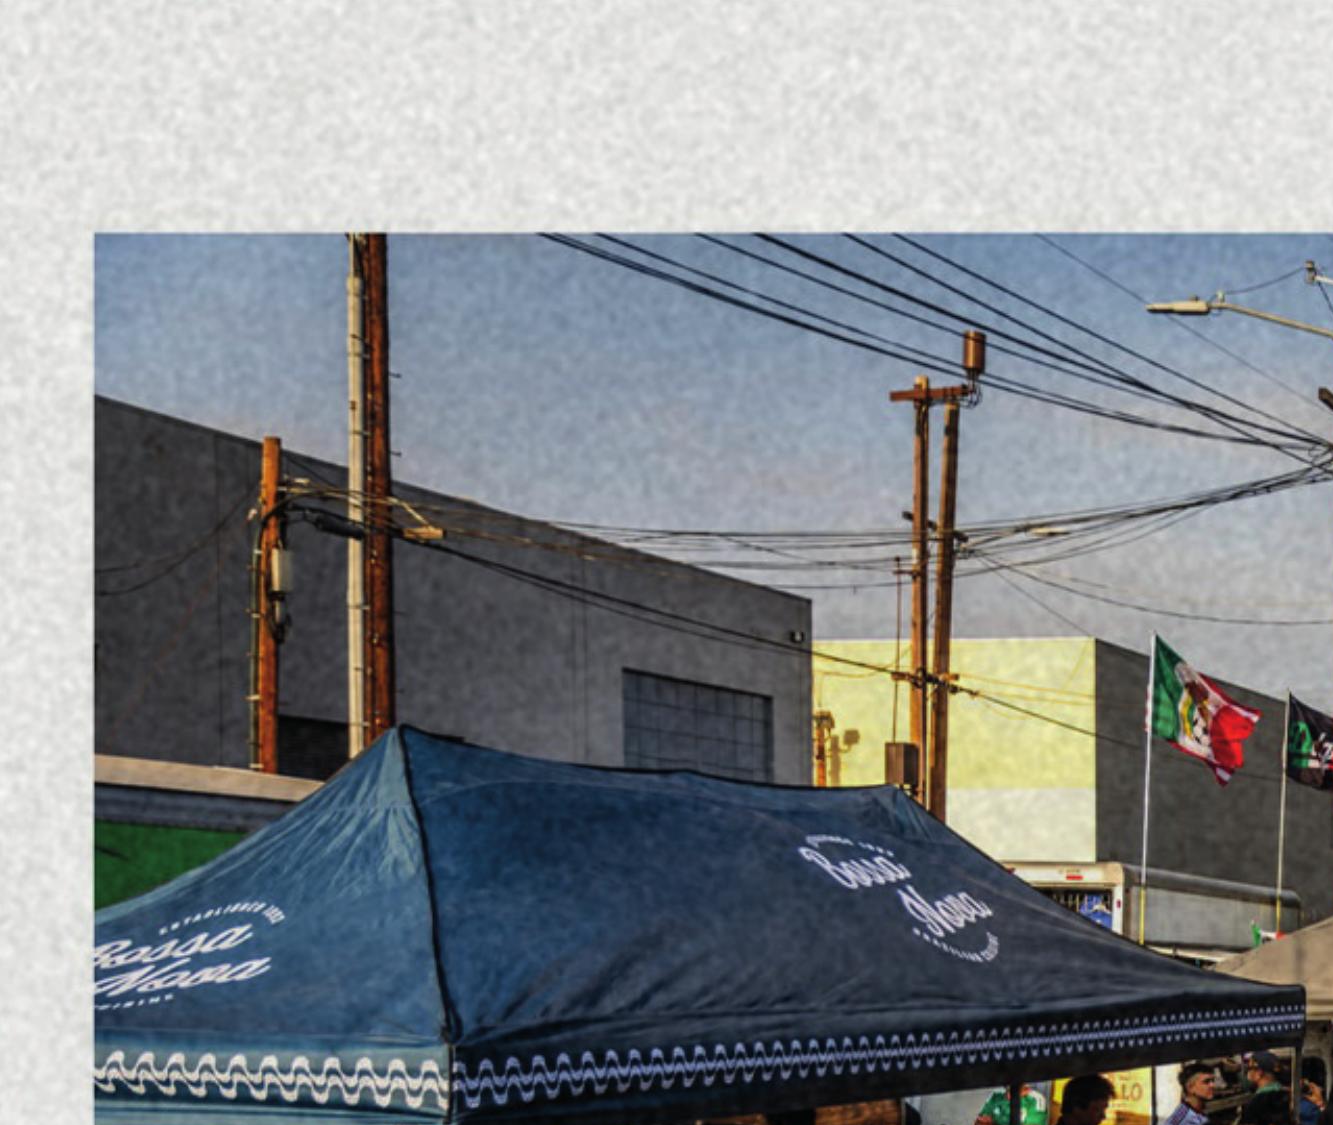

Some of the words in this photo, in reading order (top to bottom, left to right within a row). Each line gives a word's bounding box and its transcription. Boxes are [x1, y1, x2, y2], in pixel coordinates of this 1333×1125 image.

[798, 845, 912, 890] Bossa
[897, 884, 994, 938] Nova
[94, 924, 253, 970] Bossa
[94, 957, 272, 998] Nova
